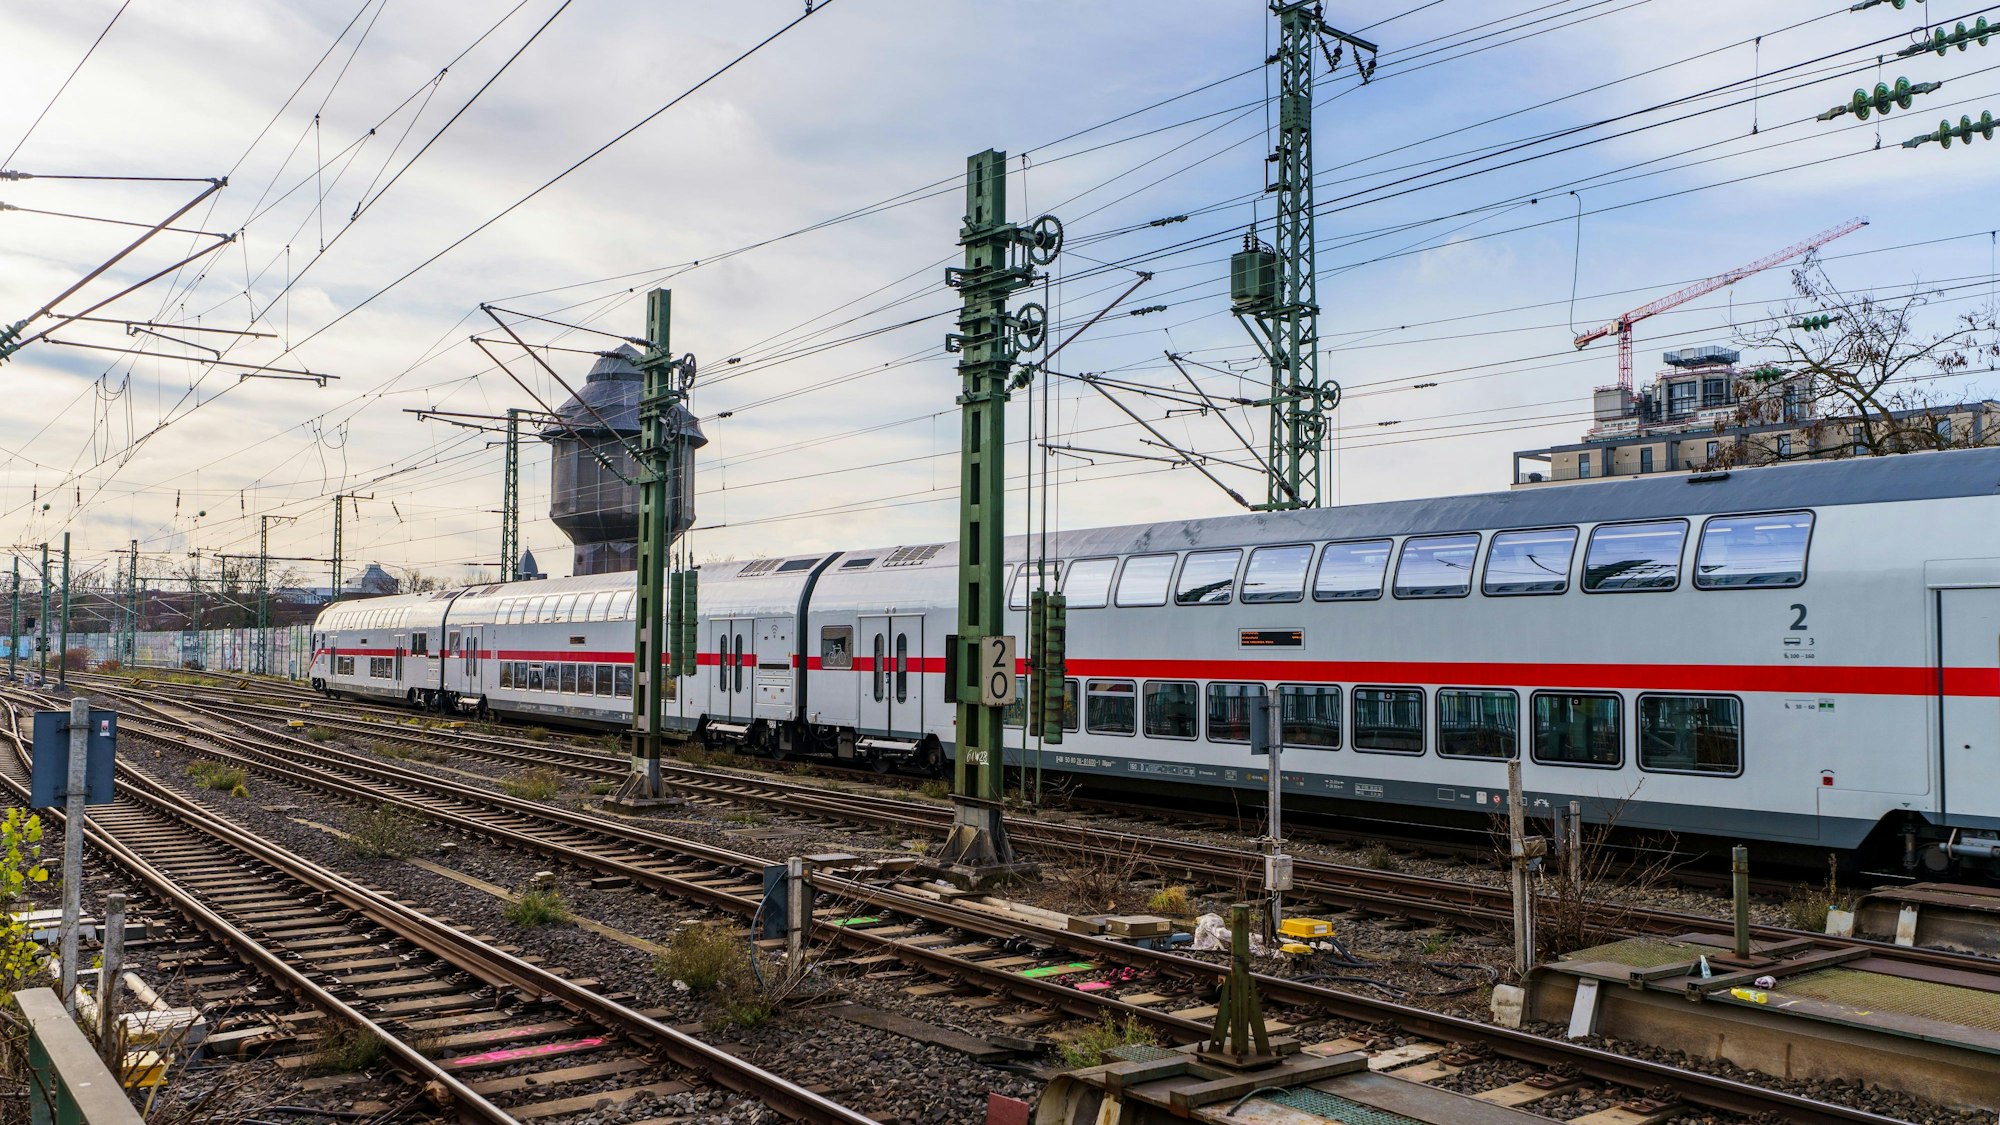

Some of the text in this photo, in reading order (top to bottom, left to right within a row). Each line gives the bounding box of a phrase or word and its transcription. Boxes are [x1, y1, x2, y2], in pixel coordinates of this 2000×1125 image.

[1790, 603, 1808, 631] 2
[992, 639, 1006, 668] 2
[1808, 637, 1815, 646] 3
[991, 671, 1008, 699] 0
